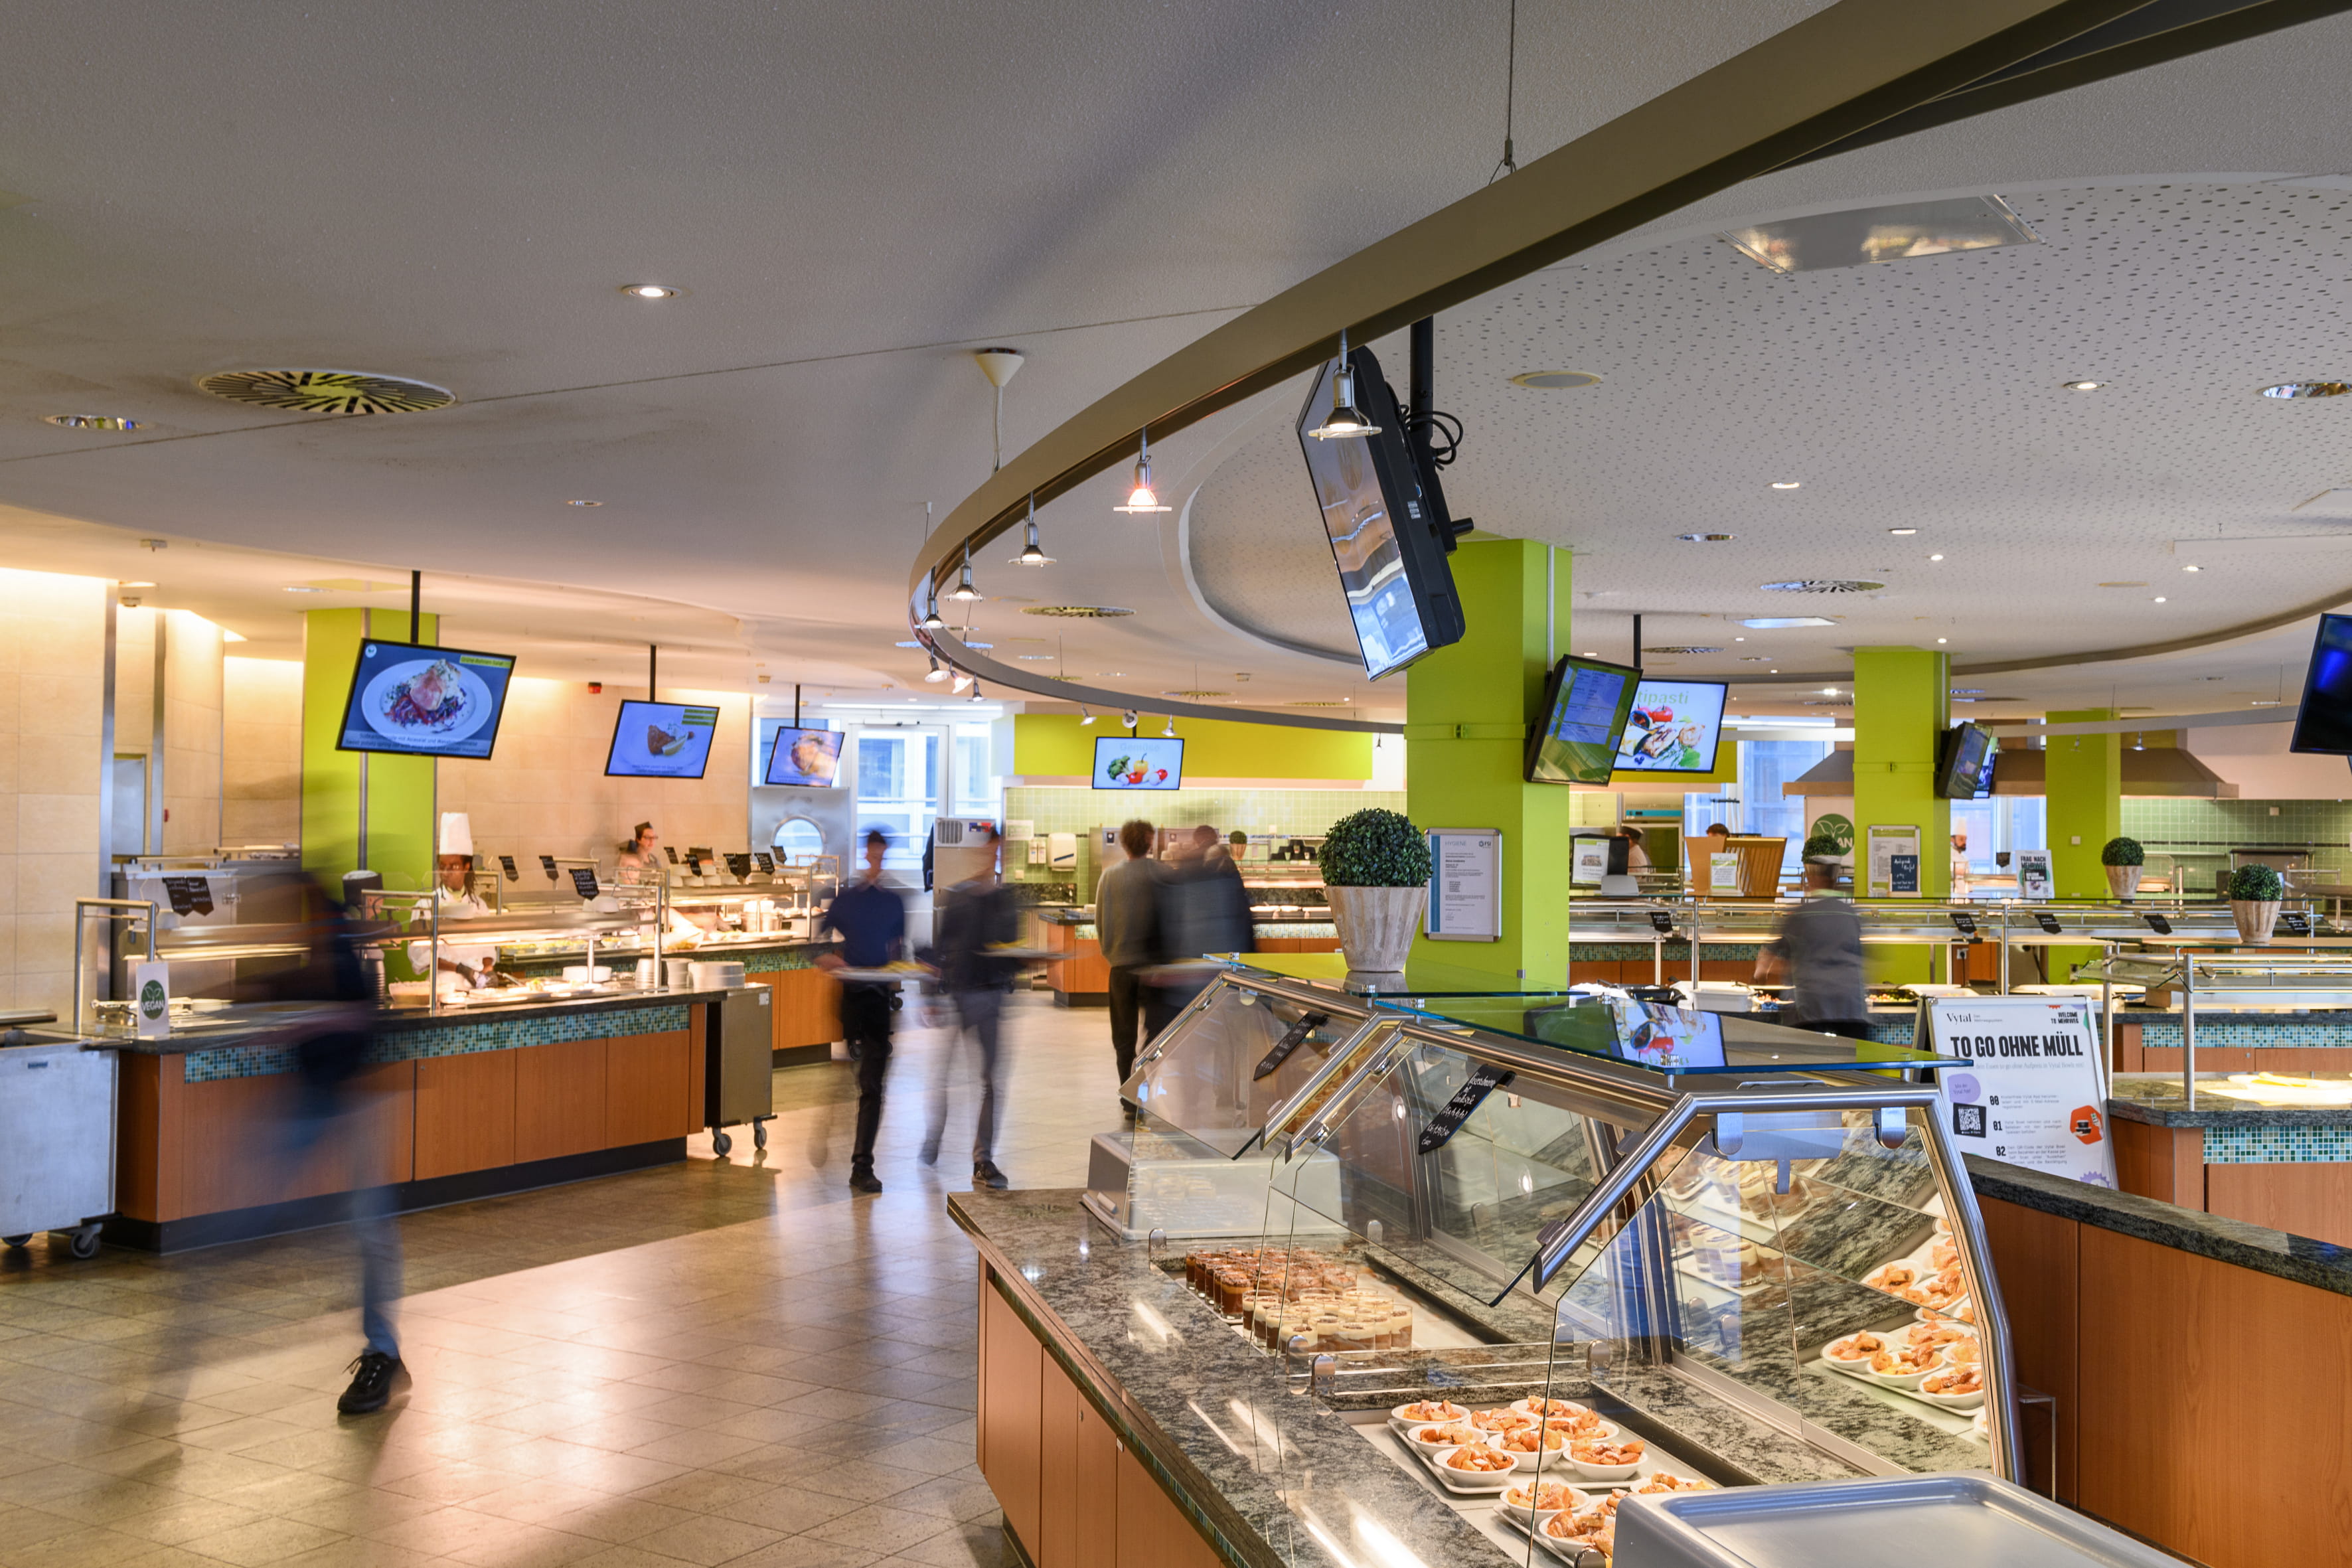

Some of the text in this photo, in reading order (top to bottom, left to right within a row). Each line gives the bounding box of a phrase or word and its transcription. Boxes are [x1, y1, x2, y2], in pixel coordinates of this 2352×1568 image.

[1637, 689, 1689, 706] tipasti
[141, 1000, 164, 1012] VEGAN
[1946, 1013, 1972, 1025] Vytal
[1950, 1031, 2083, 1058] TO GO OHNE MÜLL
[1993, 1121, 2002, 1131] 01
[1996, 1146, 2006, 1156] 02
